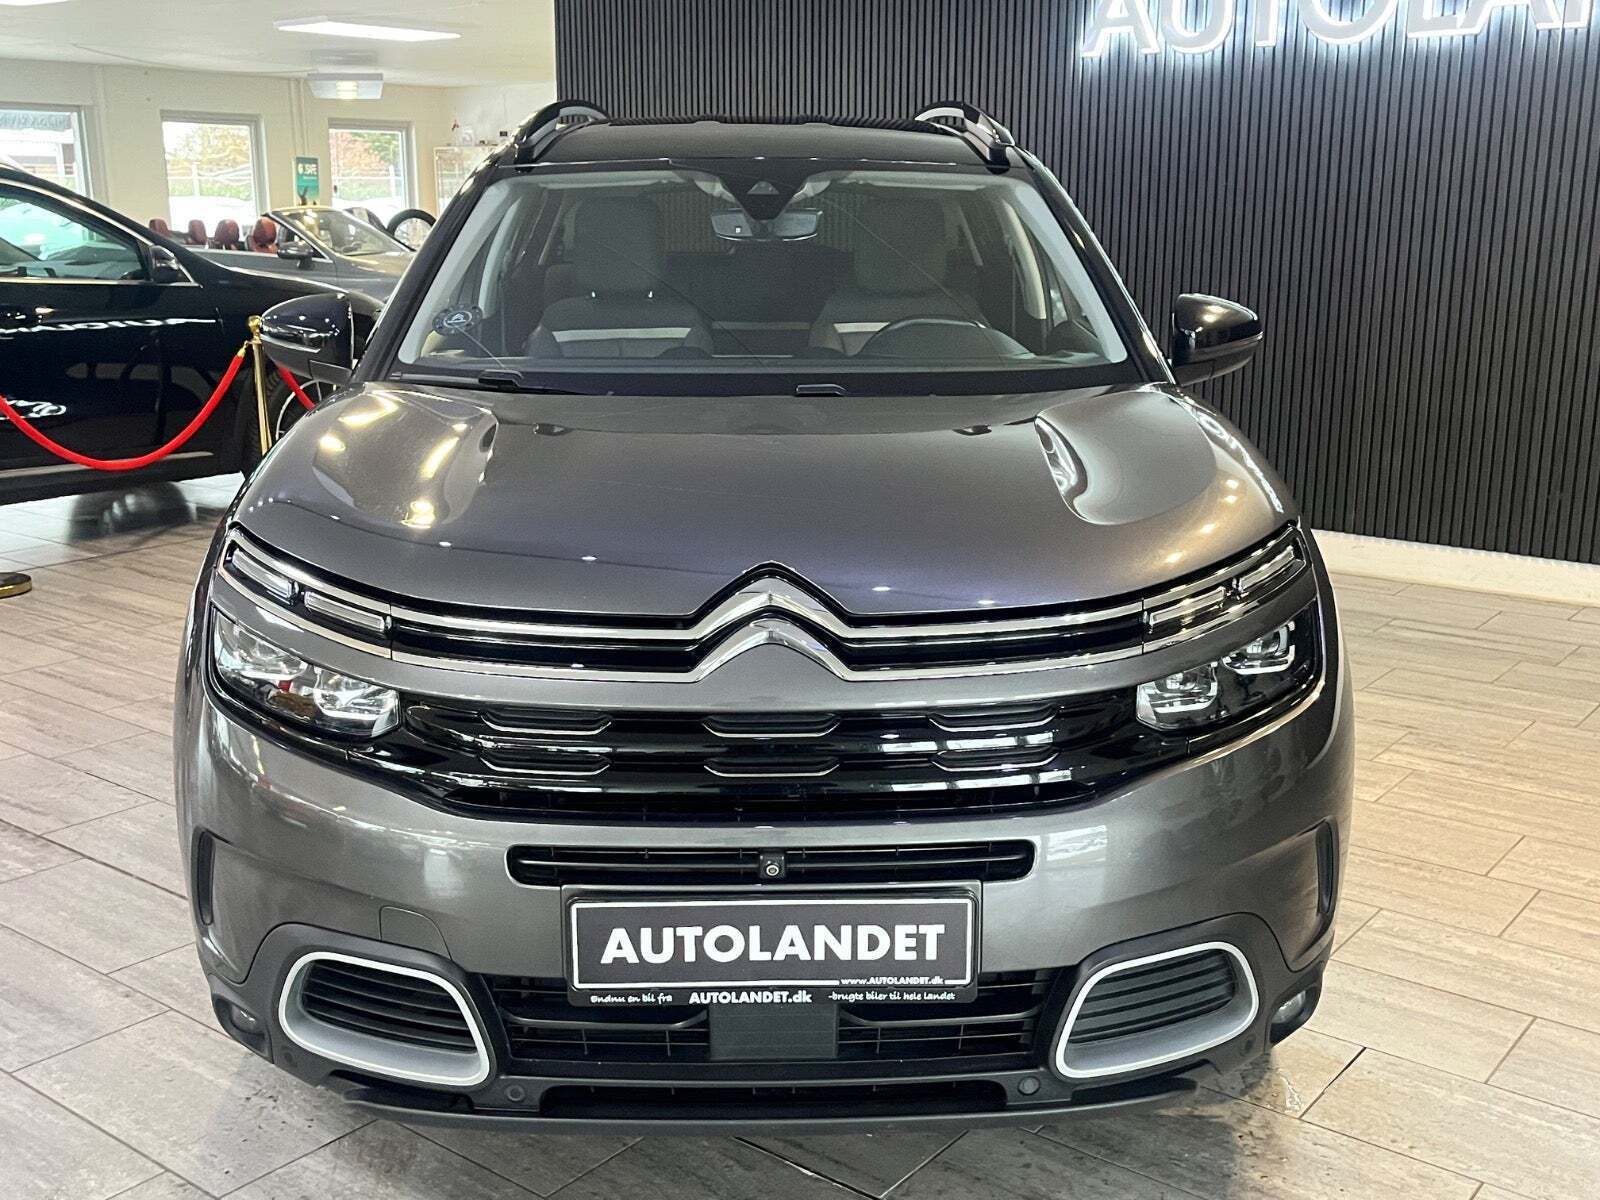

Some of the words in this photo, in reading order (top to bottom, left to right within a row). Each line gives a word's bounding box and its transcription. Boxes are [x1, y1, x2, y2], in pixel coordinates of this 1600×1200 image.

[1081, 0, 1590, 56] AUTOL
[600, 924, 946, 964] AUTOLANDET
[841, 976, 943, 985] www.AUTOLANDET.dk
[627, 994, 641, 1003] en
[641, 992, 656, 1003] bil
[657, 993, 673, 1004] fra
[688, 990, 813, 1004] AUTOLANDET.dk
[865, 991, 888, 1001] biler
[888, 991, 902, 1001] til
[902, 991, 922, 1001] hele
[923, 991, 956, 1001] landet
